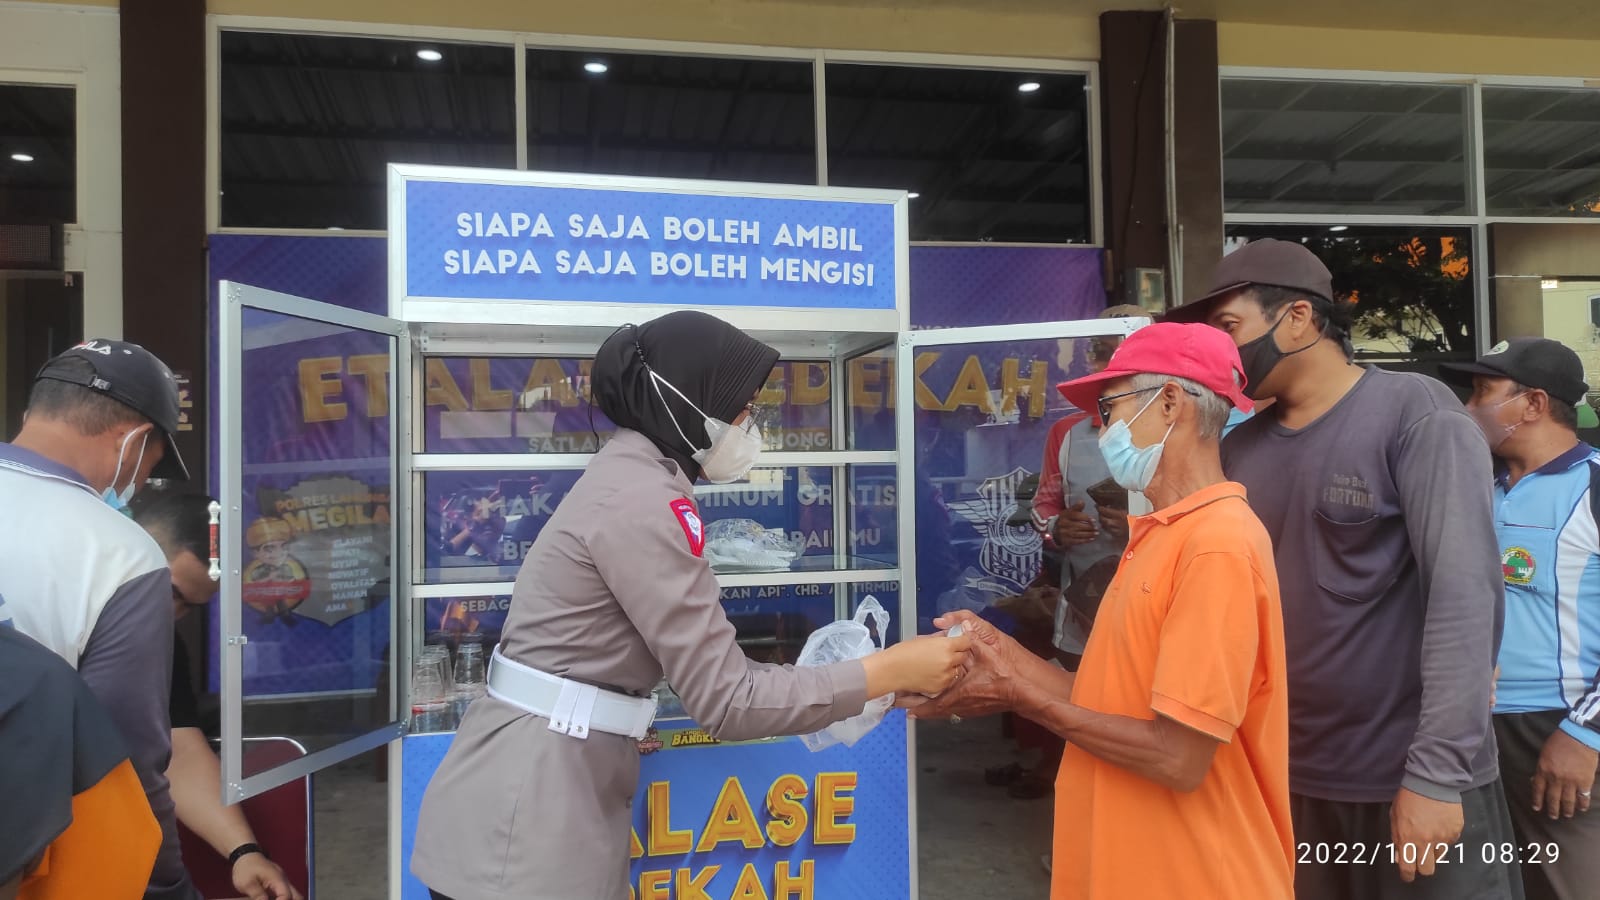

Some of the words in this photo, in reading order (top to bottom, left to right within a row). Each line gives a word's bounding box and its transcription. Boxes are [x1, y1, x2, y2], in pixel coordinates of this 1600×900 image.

[456, 212, 555, 239] SIAPA
[568, 213, 650, 241] SAJA
[663, 216, 760, 246] BOLEH
[772, 223, 863, 253] AMBIL
[444, 249, 541, 276] SIAPA
[555, 250, 637, 277] SAJA
[650, 252, 747, 281] BOLEH
[760, 259, 875, 287] MENGISI
[755, 352, 1048, 417] EDEKAH
[529, 436, 604, 453] SATLA
[283, 505, 389, 532] MEGILA
[479, 491, 568, 519] MAK
[797, 483, 897, 507] GRTIS
[460, 598, 510, 613] SEBAG
[720, 586, 752, 600] KAN
[630, 771, 857, 857] LASE
[629, 858, 816, 900] EKAH
